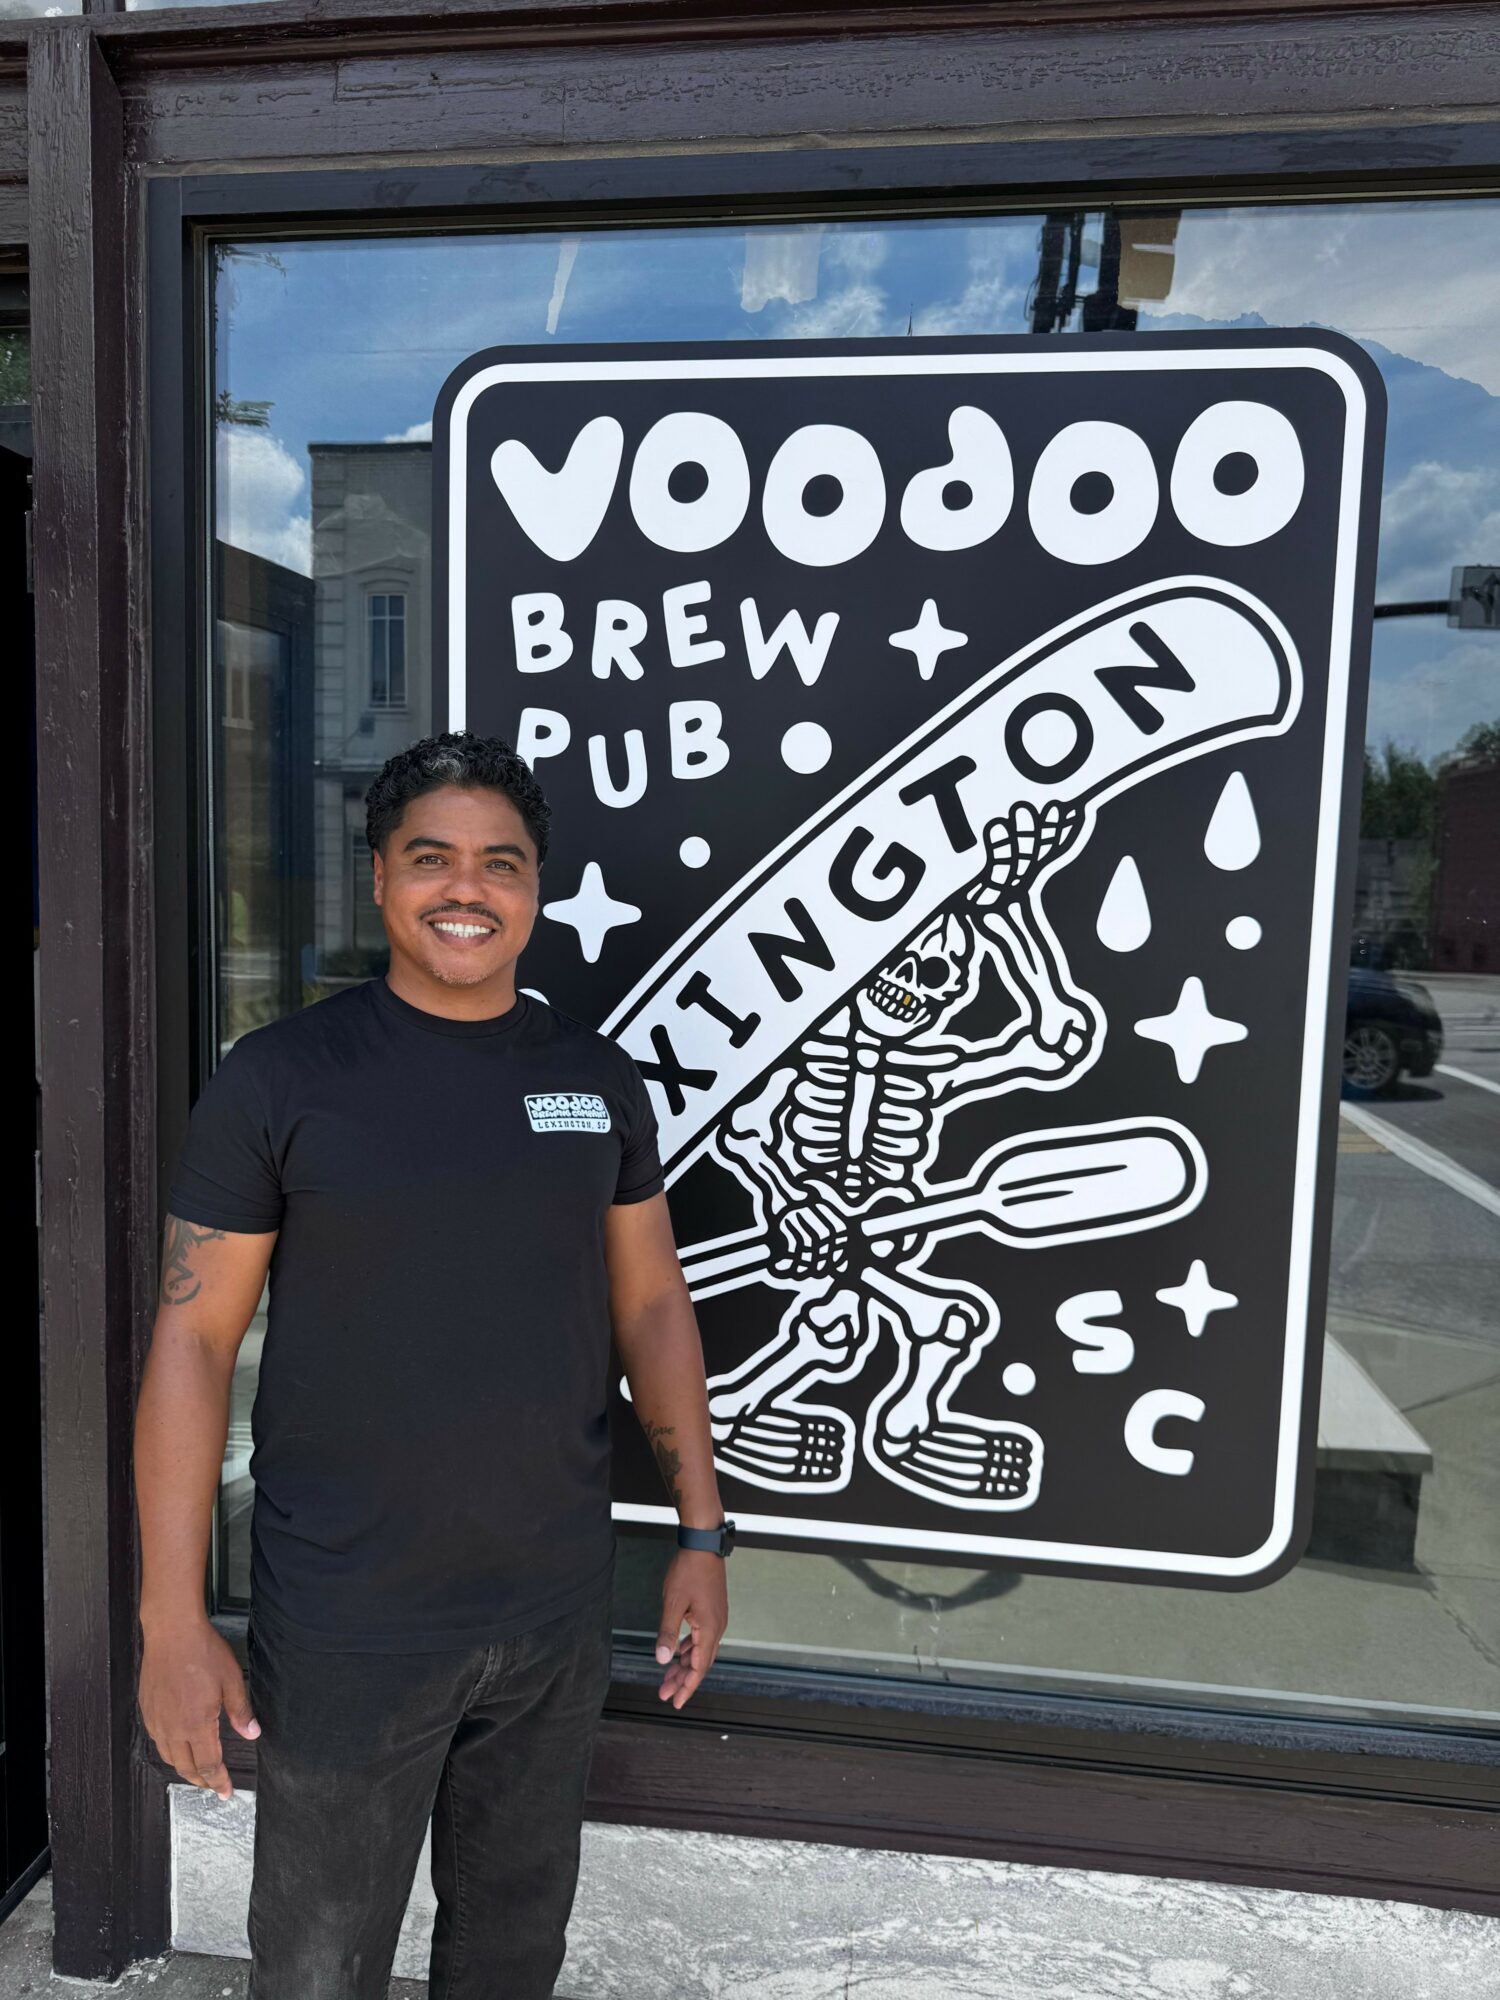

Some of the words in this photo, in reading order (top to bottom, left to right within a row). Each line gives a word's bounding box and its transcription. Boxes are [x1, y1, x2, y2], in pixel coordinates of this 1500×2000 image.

[512, 581, 840, 686] BREW
[516, 701, 729, 808] PUB
[634, 622, 1195, 1116] XINGTON
[572, 1108, 607, 1119] COMPANY
